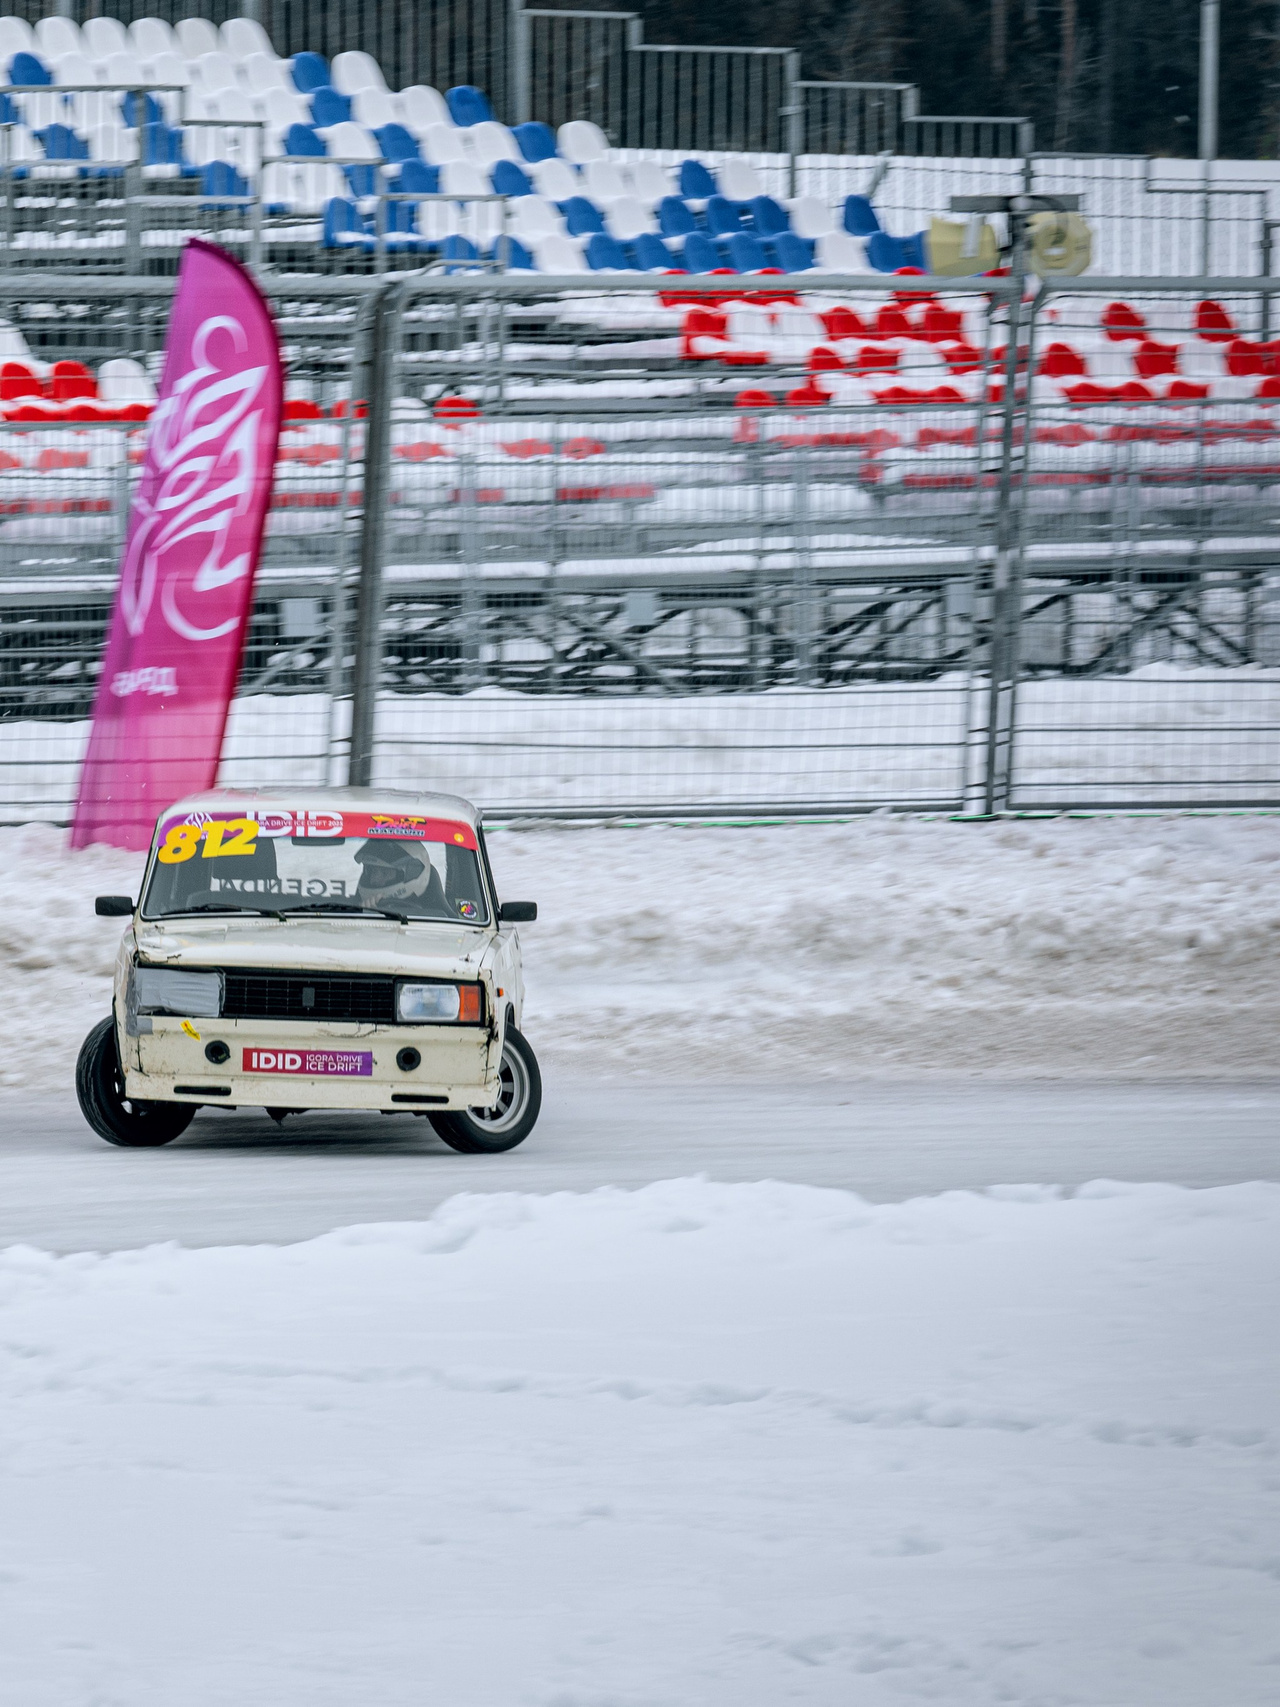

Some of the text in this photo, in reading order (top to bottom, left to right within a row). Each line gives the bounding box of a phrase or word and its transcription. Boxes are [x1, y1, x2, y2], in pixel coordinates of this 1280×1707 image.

[271, 820, 292, 828] DRIVE
[306, 820, 327, 828] DRIFT
[158, 818, 259, 864] 812
[251, 1052, 302, 1070] IDID
[306, 1054, 362, 1063] IGORA DRIVE
[306, 1062, 362, 1072] ICE DRIFT
